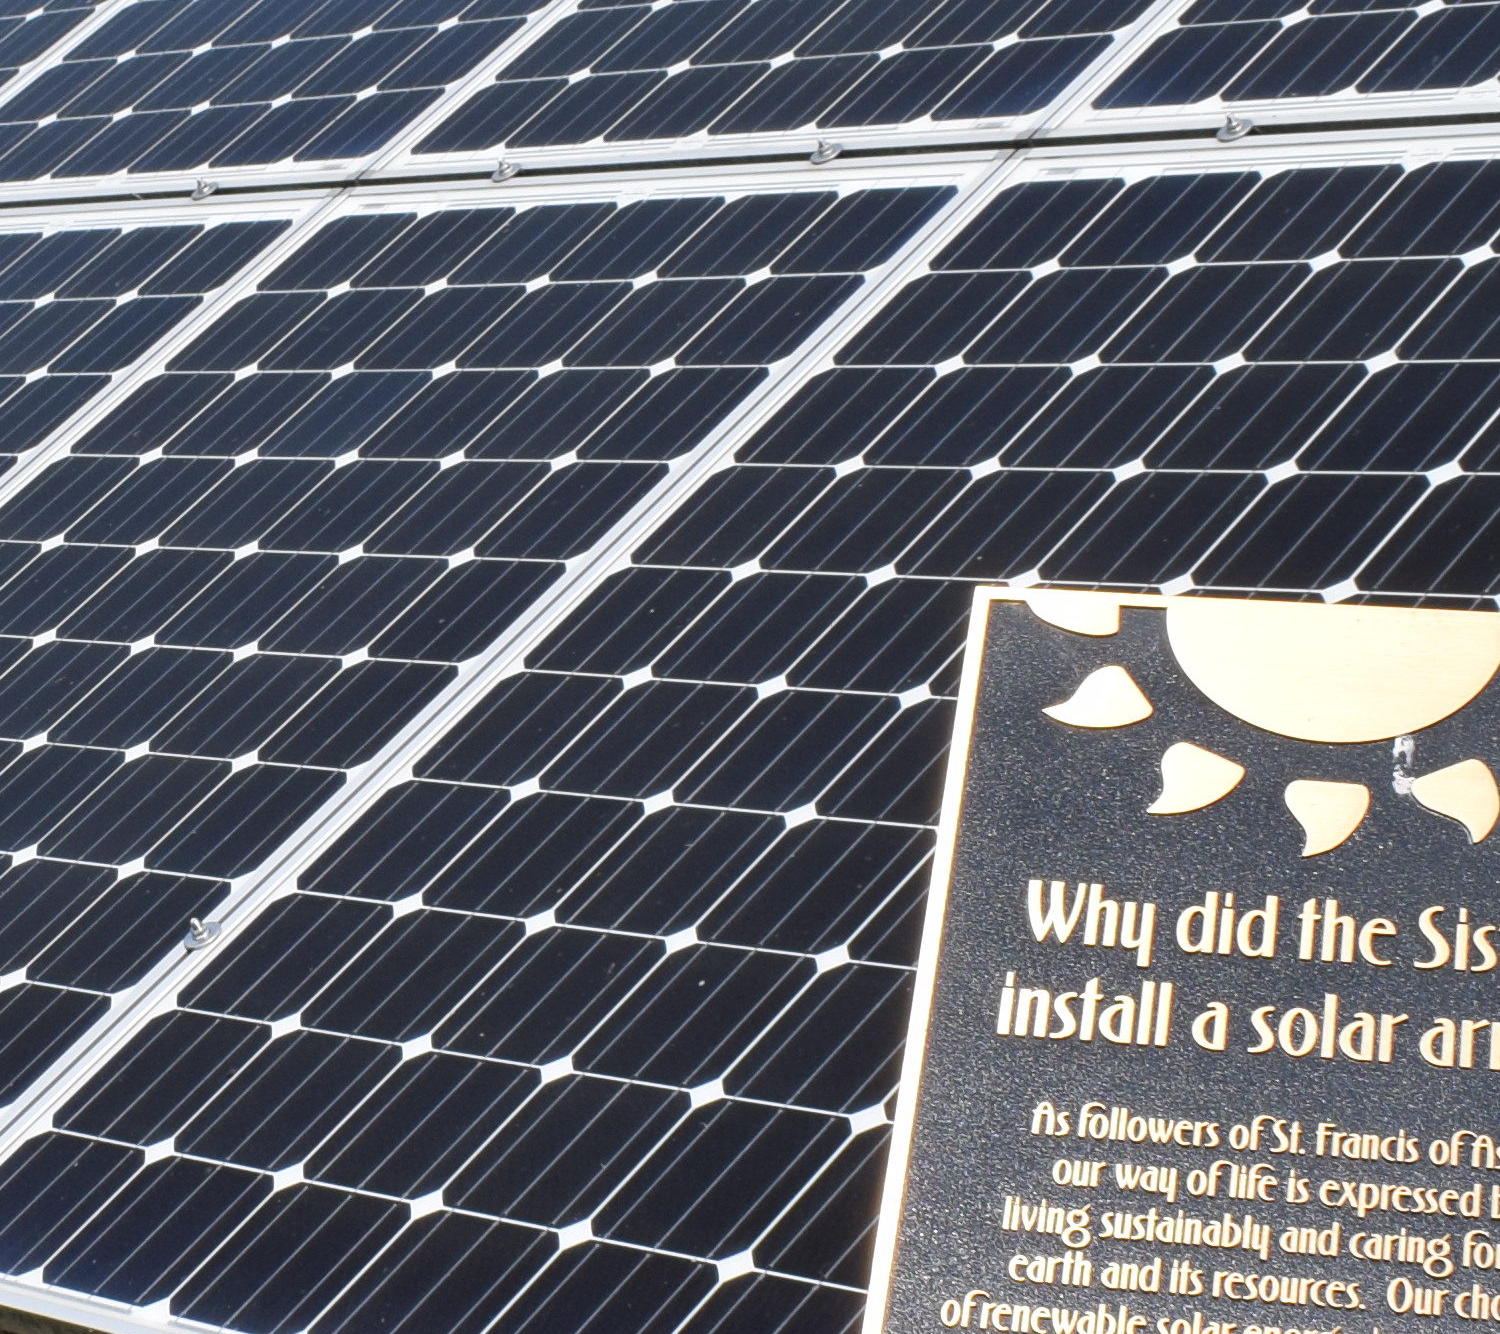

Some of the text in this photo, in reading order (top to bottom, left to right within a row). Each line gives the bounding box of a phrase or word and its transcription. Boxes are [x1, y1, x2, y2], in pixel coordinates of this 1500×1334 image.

[1026, 878, 1156, 967] Why
[1175, 891, 1279, 957] did
[1298, 898, 1397, 965] the
[996, 970, 1173, 1046] install
[1191, 1001, 1228, 1051] a
[1247, 993, 1409, 1063] solar
[1030, 1100, 1070, 1136] As
[1077, 1101, 1220, 1147] followers
[1228, 1113, 1277, 1152] of
[1268, 1118, 1308, 1156] St.
[1315, 1122, 1419, 1163] Francis
[1428, 1129, 1479, 1168] of
[1051, 1158, 1107, 1187] our
[1114, 1163, 1178, 1203] way
[1185, 1159, 1237, 1198] of
[1227, 1162, 1279, 1203] life
[1285, 1168, 1310, 1203] is
[1318, 1179, 1482, 1218] expressed
[1001, 1195, 1091, 1248] living
[1098, 1207, 1271, 1260] sustainably
[1279, 1221, 1340, 1256] and
[1348, 1227, 1454, 1277] caring
[939, 1288, 990, 1328] of
[1007, 1250, 1092, 1287] earth
[1100, 1256, 1162, 1292] and
[1168, 1258, 1204, 1295] its
[1211, 1270, 1368, 1311] resources.
[1386, 1277, 1450, 1315] Our
